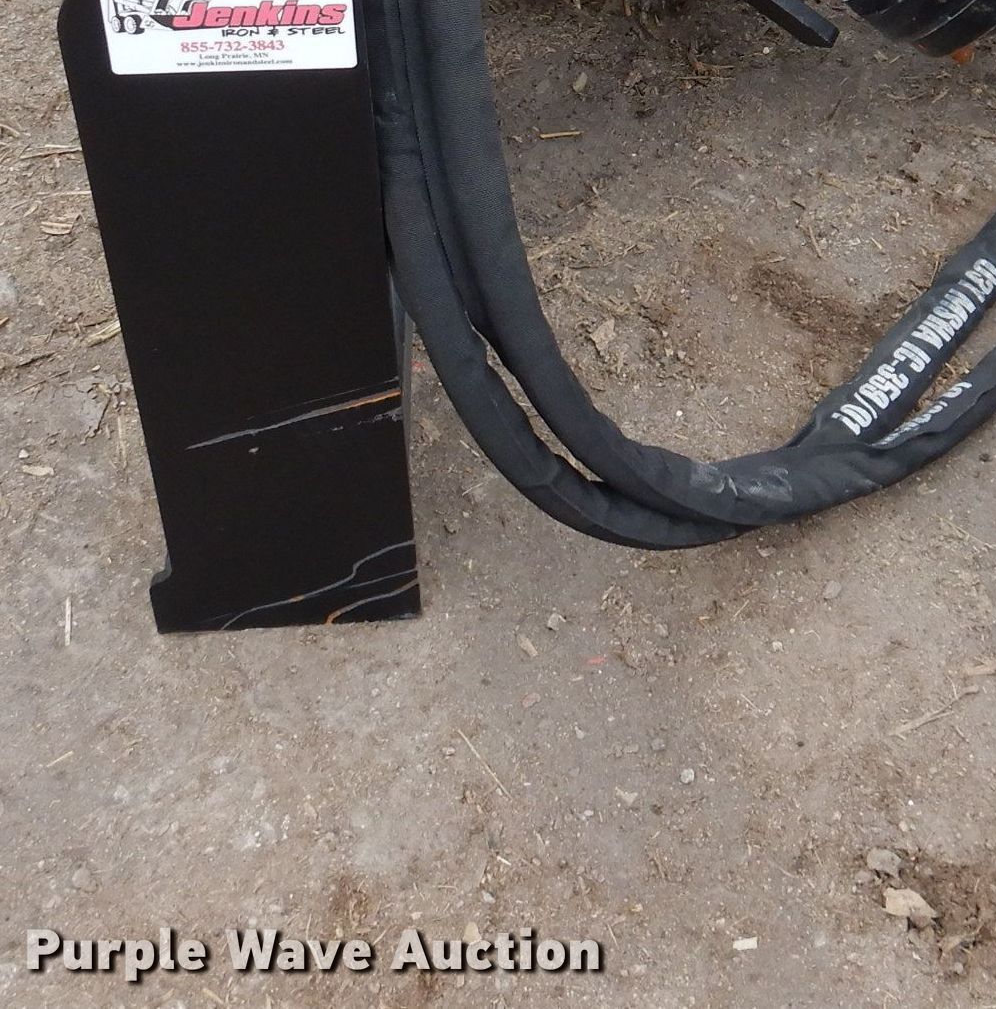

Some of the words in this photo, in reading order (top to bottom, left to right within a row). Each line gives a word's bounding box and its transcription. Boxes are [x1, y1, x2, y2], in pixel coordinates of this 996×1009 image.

[171, 0, 347, 30] Jenkins
[221, 27, 260, 38] IRON
[287, 27, 346, 36] STEEL
[179, 40, 286, 53] 855-732-3843
[199, 53, 219, 61] Long
[911, 288, 977, 351] MSHA
[831, 341, 932, 436] IC-359/01
